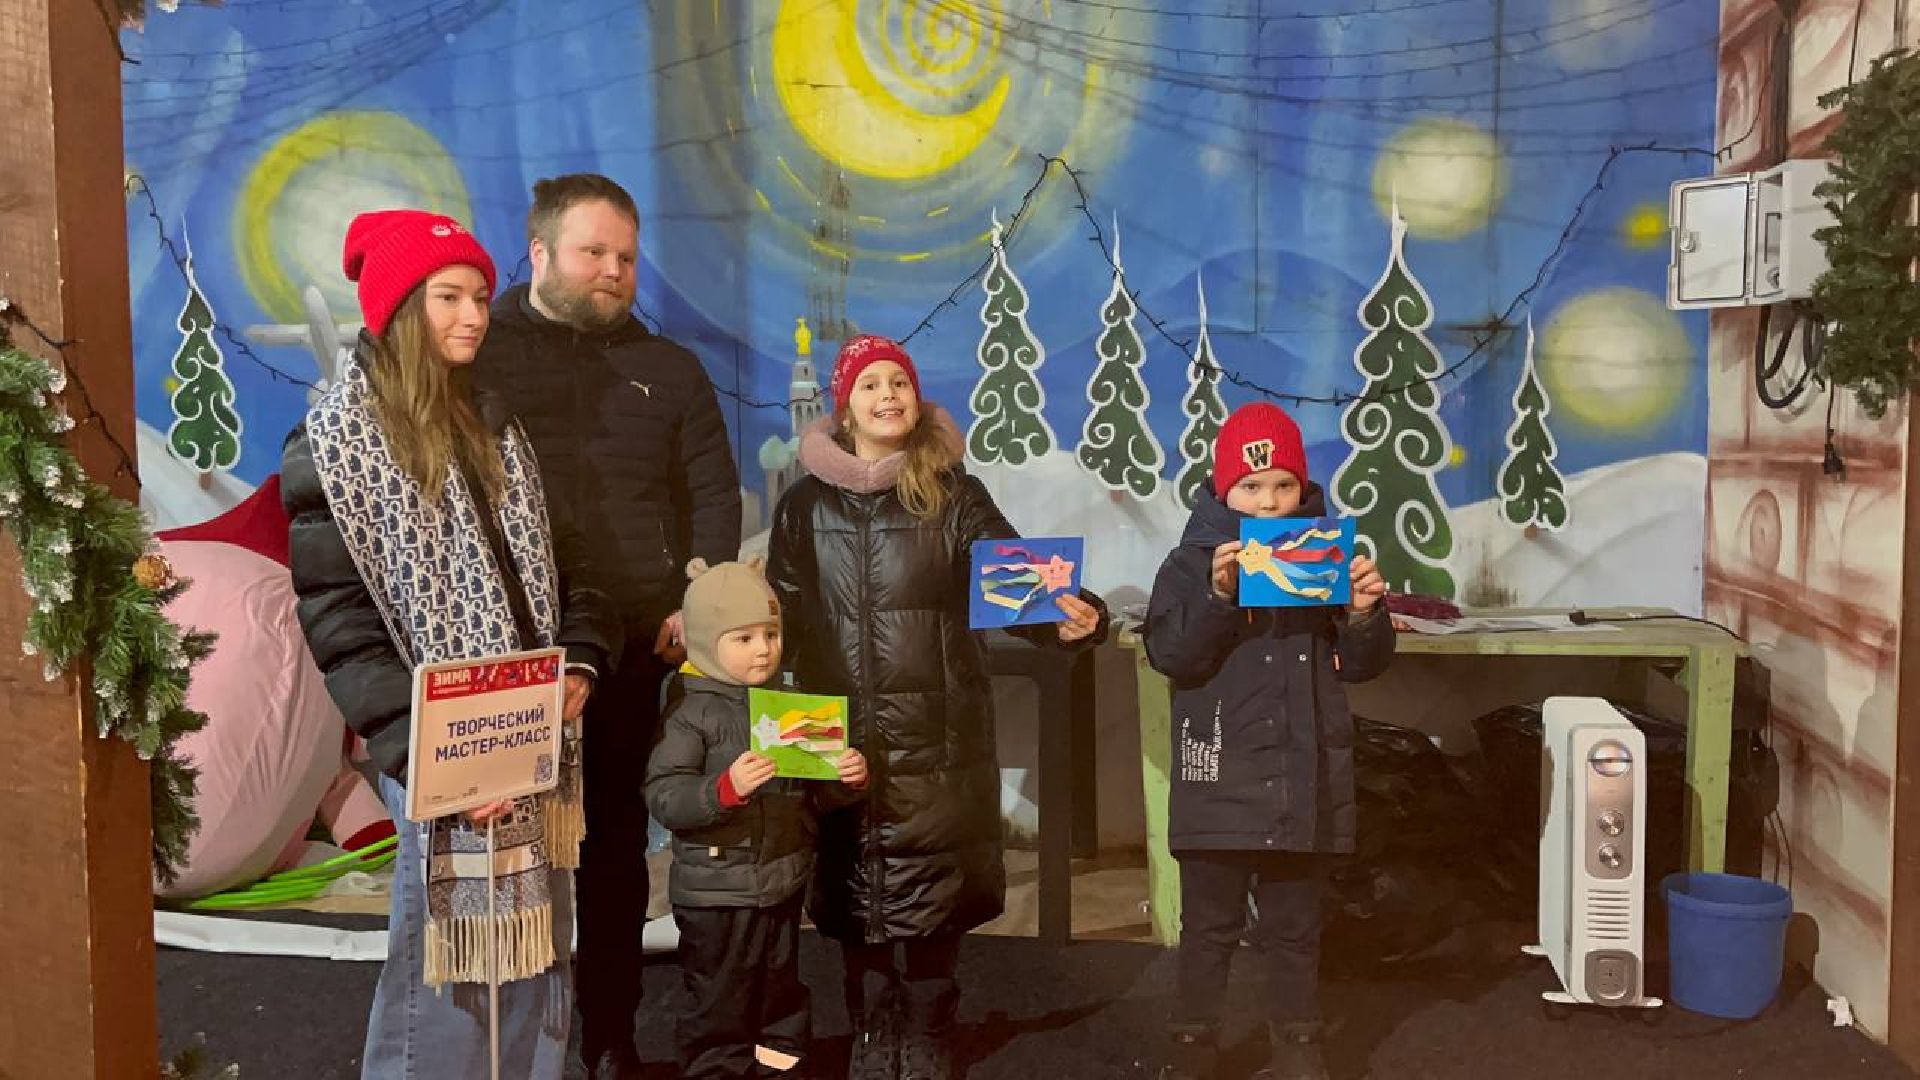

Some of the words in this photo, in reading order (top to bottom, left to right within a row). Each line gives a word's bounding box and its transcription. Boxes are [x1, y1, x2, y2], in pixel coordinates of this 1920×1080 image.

[433, 669, 472, 687] ЗИМА
[447, 703, 545, 739] ТВОРЧЕСКИЙ
[435, 726, 551, 763] МАСТЕР-КЛАСС
